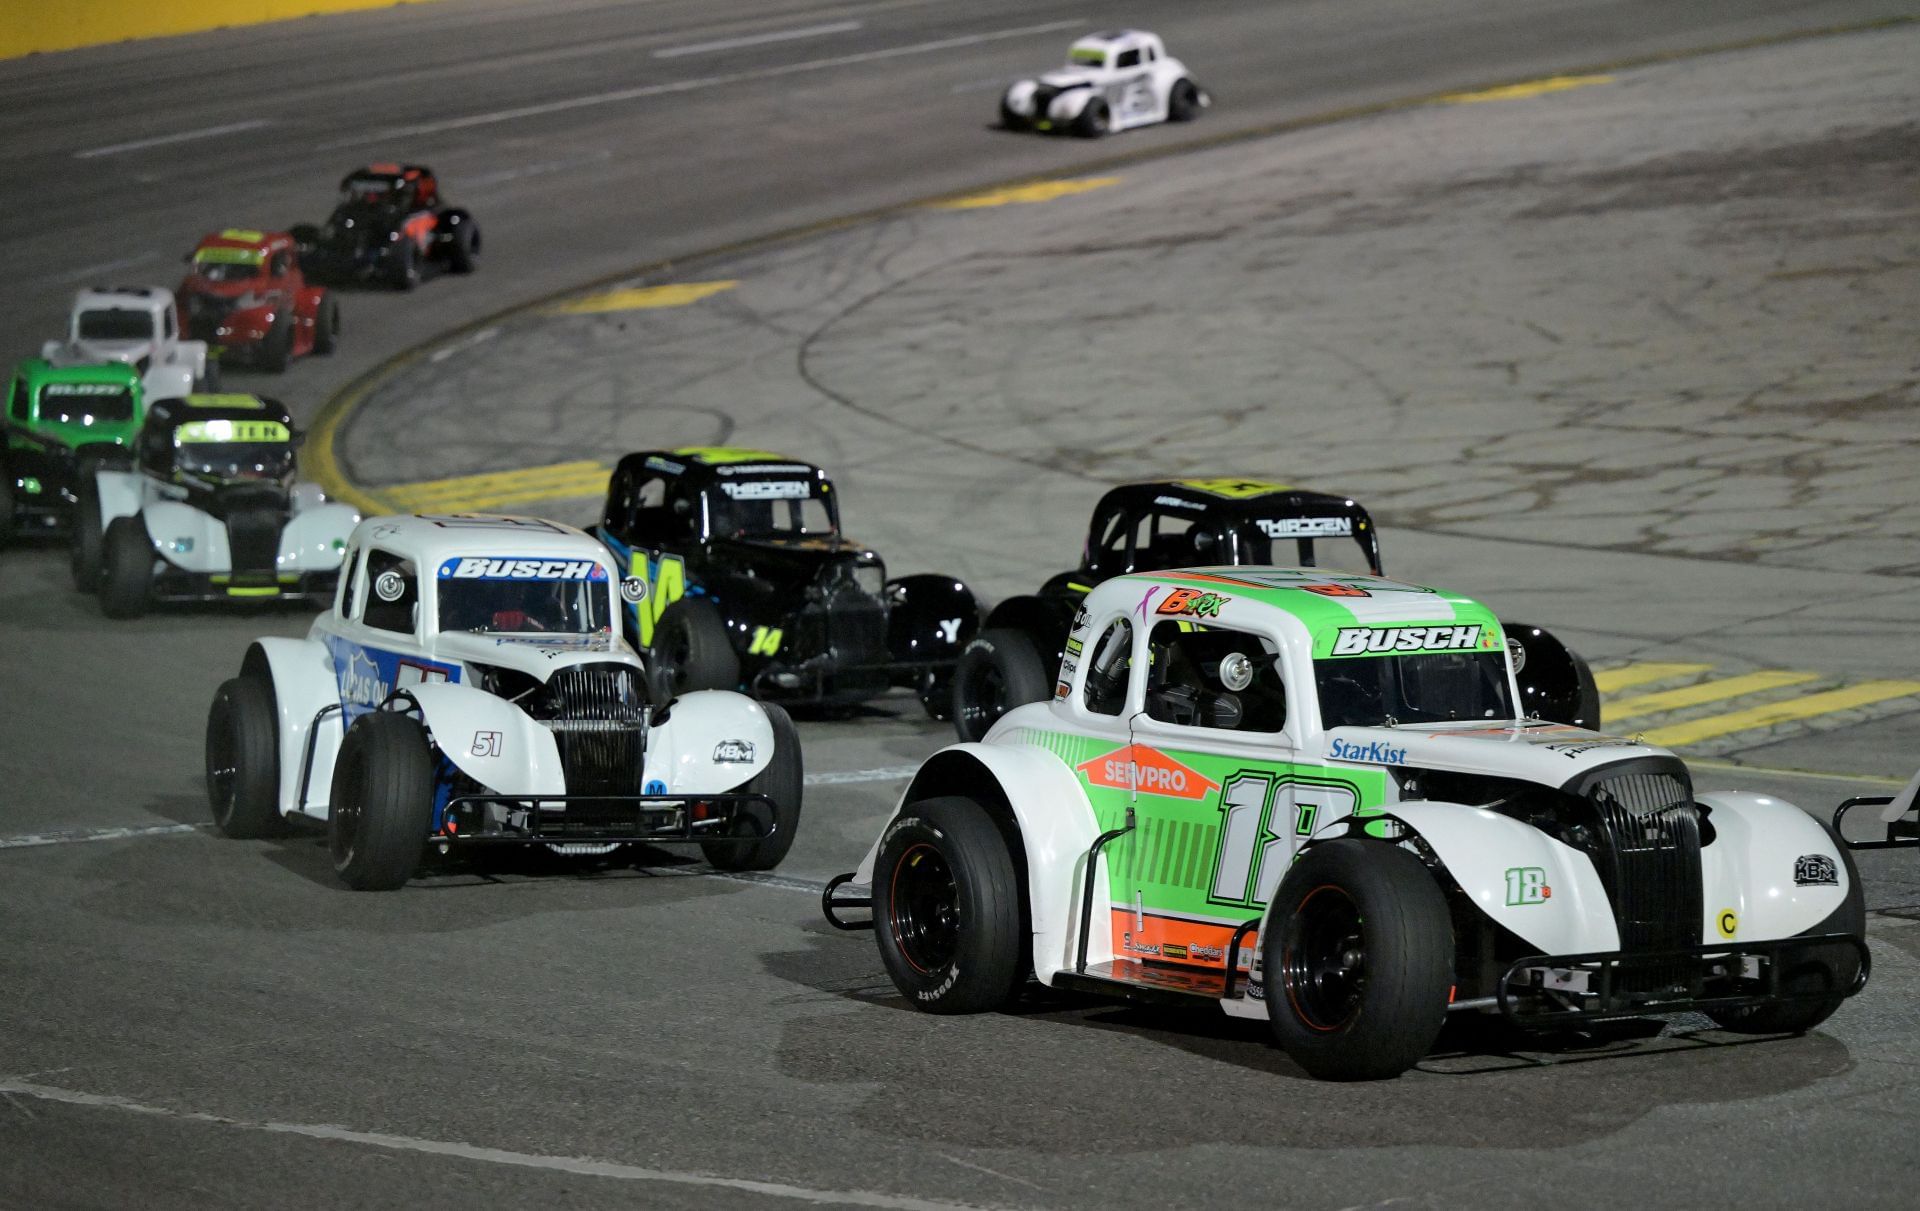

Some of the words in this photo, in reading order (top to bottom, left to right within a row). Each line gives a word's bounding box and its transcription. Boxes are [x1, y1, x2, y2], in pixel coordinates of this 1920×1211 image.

[452, 557, 592, 579] BUSCH
[748, 625, 783, 656] 14
[939, 617, 962, 643] Y
[1331, 625, 1481, 656] BUSCH
[471, 731, 502, 757] 51
[713, 743, 753, 761] KBM
[1330, 738, 1407, 764] StarKist
[649, 784, 663, 796] M
[1793, 861, 1837, 882] KBM
[1505, 867, 1546, 906] 18
[1721, 913, 1735, 934] C
